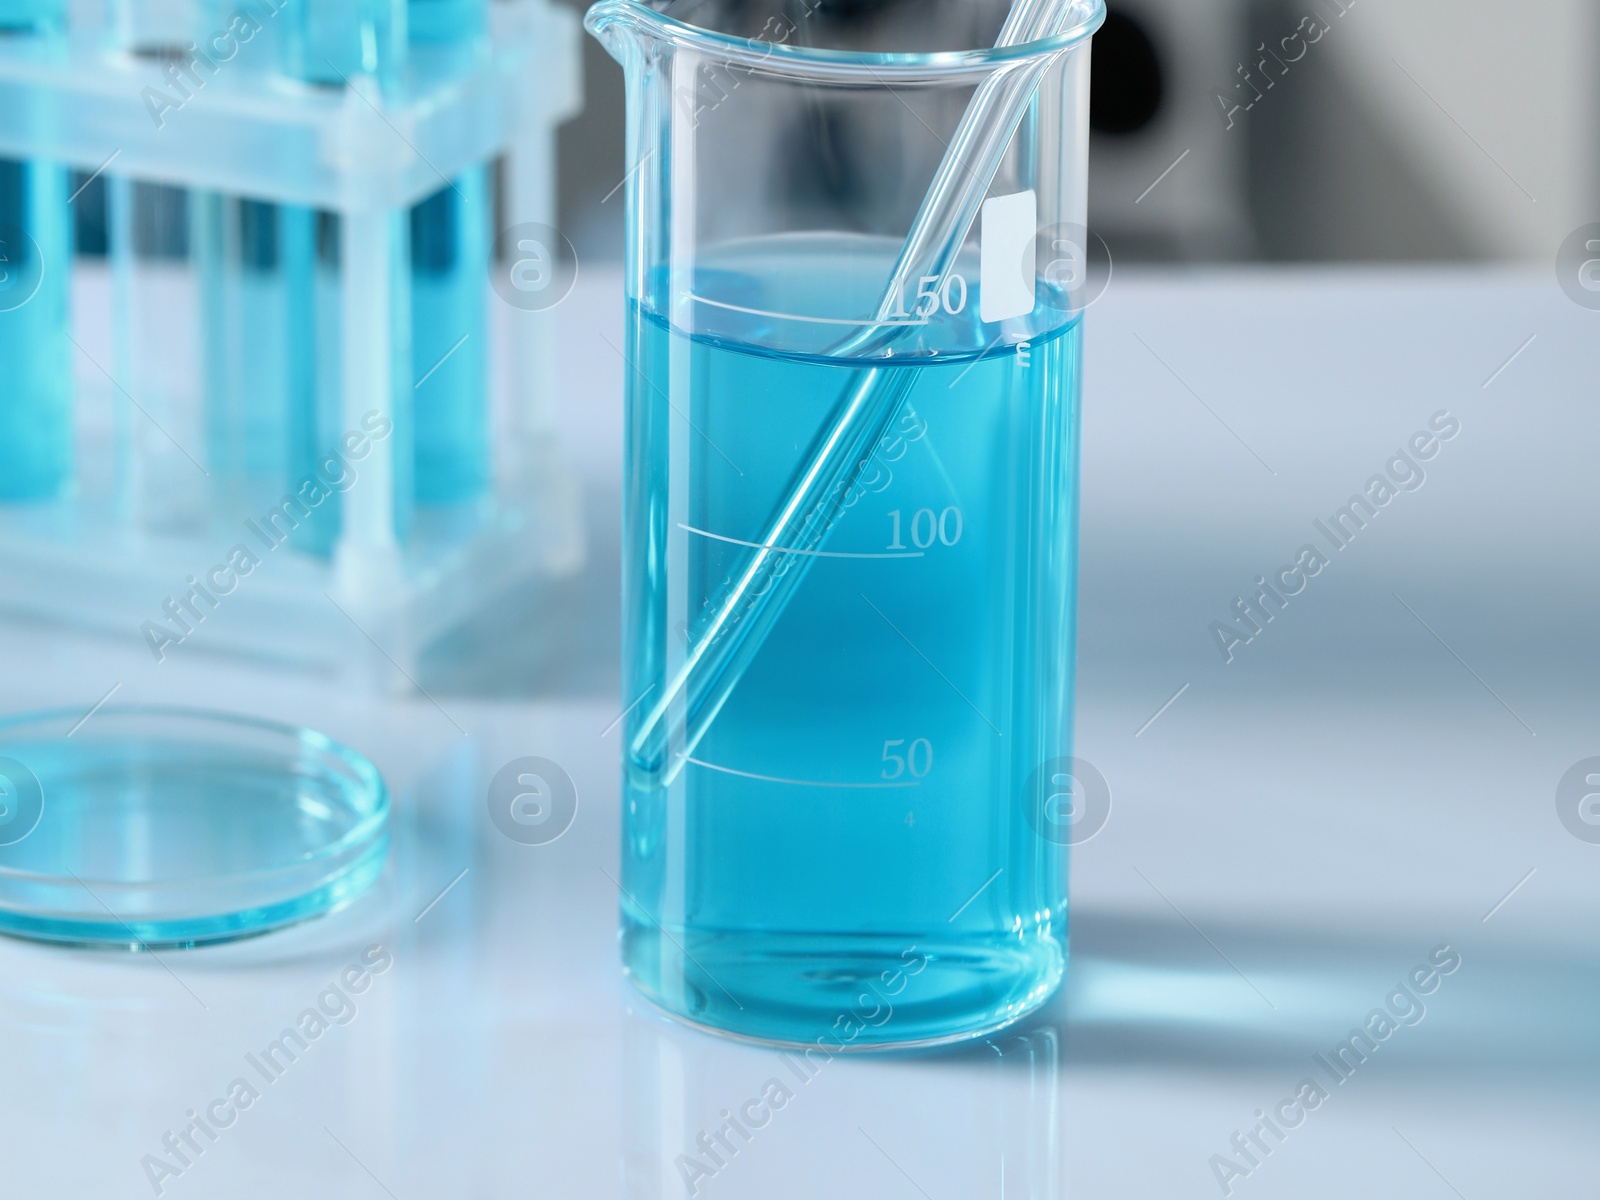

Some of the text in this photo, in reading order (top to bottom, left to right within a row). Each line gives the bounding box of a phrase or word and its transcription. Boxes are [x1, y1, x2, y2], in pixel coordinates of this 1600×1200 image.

[891, 274, 967, 317] 150
[886, 506, 963, 549] 100
[880, 738, 934, 779] 50
[904, 810, 916, 828] 4
